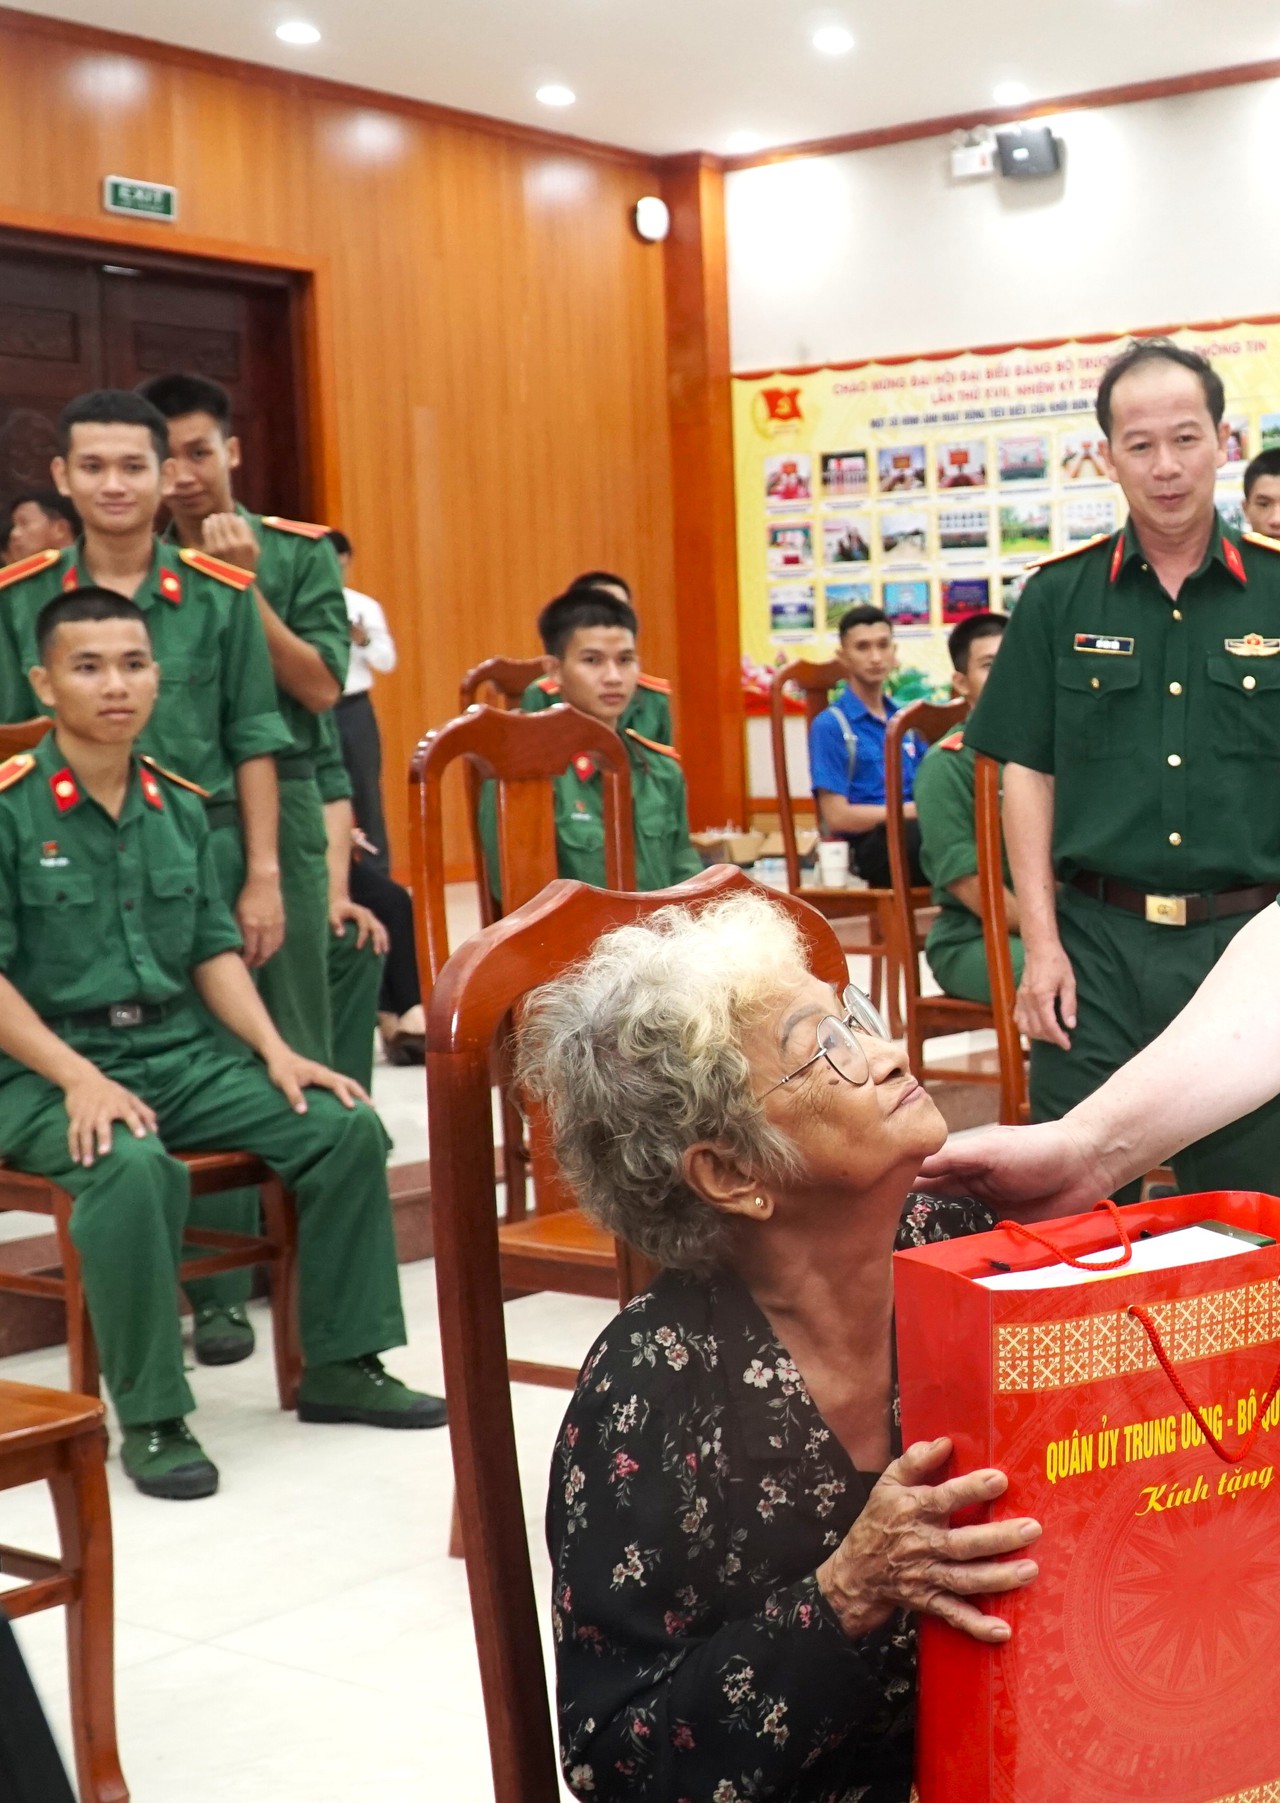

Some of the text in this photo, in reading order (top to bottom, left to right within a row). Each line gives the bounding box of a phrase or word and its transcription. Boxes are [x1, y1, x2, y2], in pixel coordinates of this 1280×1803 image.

[118, 185, 163, 203] EXIT
[1046, 1429, 1093, 1484] QUÂN
[1098, 1414, 1121, 1469] ỦY
[1123, 1414, 1177, 1463] TRUNG
[1134, 1462, 1275, 1516] Kính tặng
